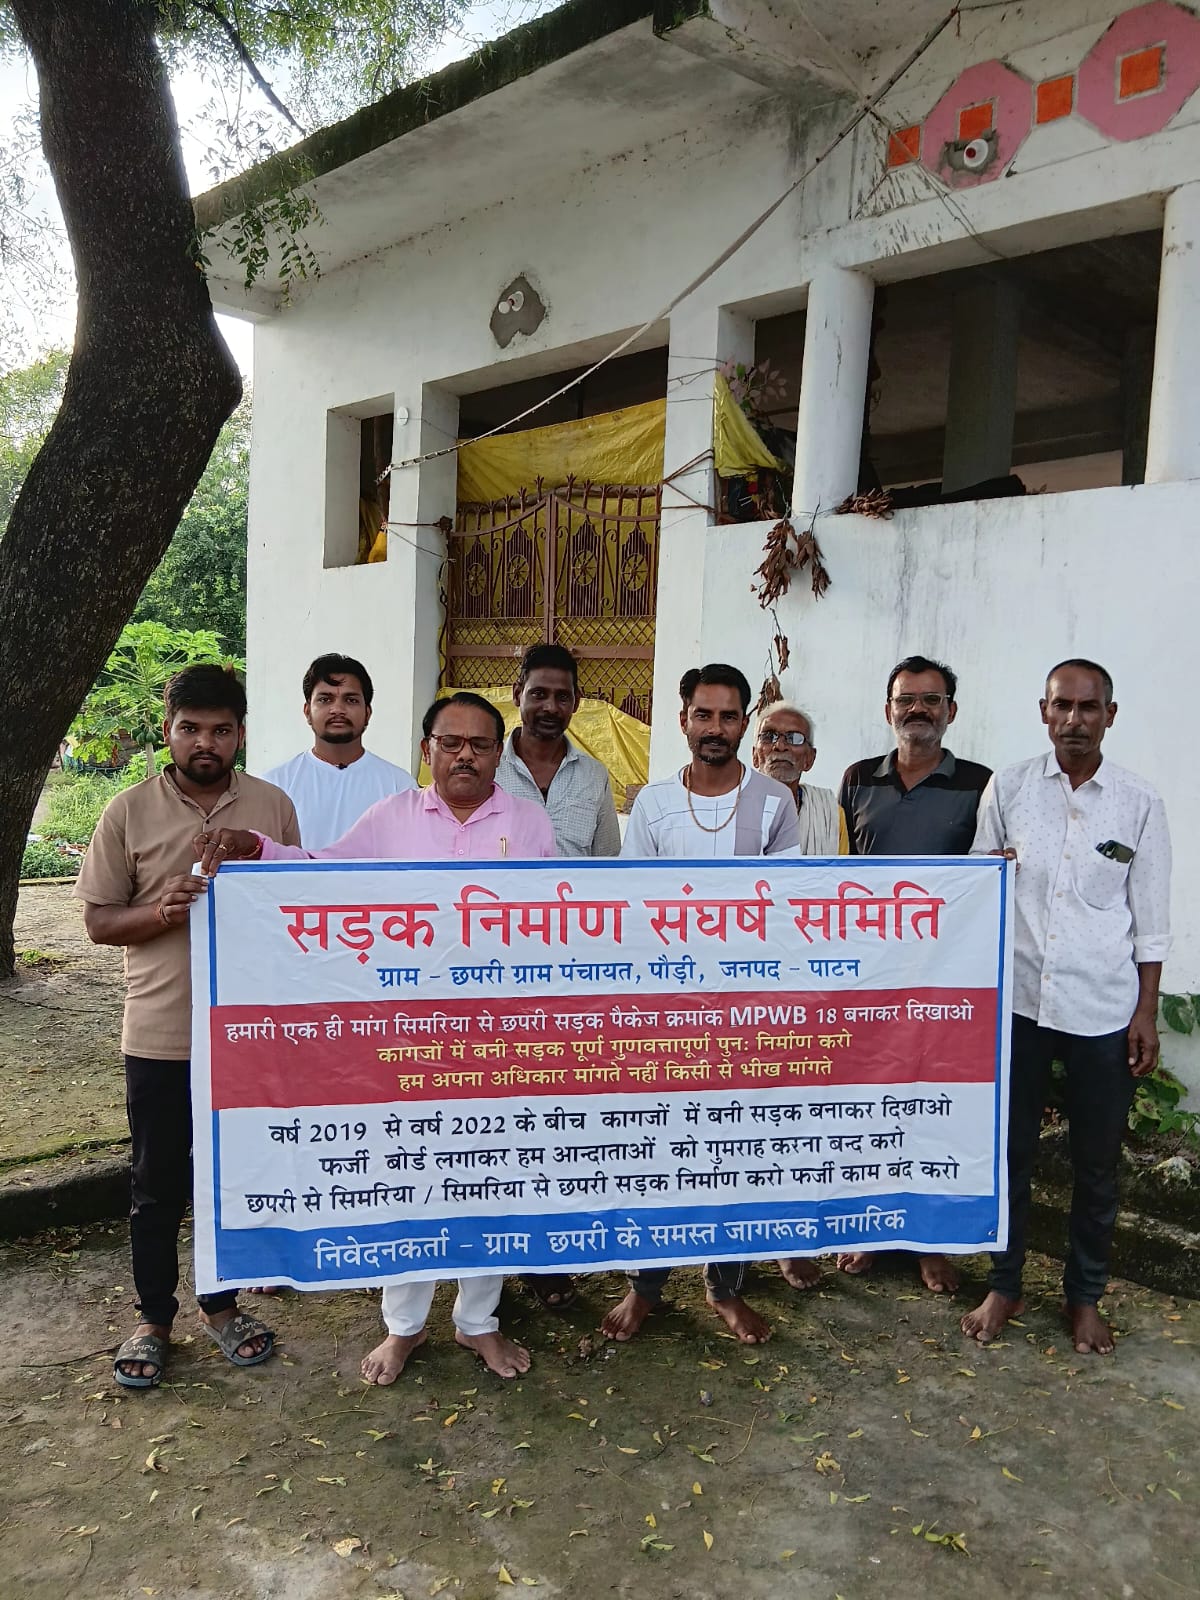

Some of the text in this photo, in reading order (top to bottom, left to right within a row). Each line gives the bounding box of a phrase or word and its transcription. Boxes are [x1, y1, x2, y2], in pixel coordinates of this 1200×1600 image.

[279, 880, 946, 965] सड़क निर्माण संघर्ष समिति
[377, 967, 421, 987] ग्राम
[449, 959, 505, 985] छपरी
[511, 965, 553, 984] ग्राम
[560, 958, 641, 984] पंचायत,
[648, 954, 705, 984] पौड़ी,
[719, 960, 781, 980] जनपद
[808, 958, 861, 979] पाटन
[225, 998, 974, 1045] हमारी एक ही मांग सिमरिया से छपरी सड़क पैकेज क्रमांक MPWB 18 बनाकर दिखाओ
[377, 1040, 443, 1063] कागजों
[450, 1039, 466, 1060] में
[473, 1038, 508, 1058] बनी
[515, 1042, 564, 1060] सड़क
[571, 1035, 604, 1061] पूर्ण
[609, 1031, 710, 1060] गुणवत्तापूर्ण
[757, 1031, 813, 1050] निर्माण
[819, 1029, 852, 1048] करो
[398, 1058, 833, 1089] हम अपना अधिकार मांगते नहीं किसी से भीख मांगते
[269, 1094, 953, 1145] वर्ष 2019 से वर्ष 2022 के बीच कागजों में बनी सड़क बनाकर दिखाओ
[318, 1149, 370, 1176] फर्जी
[384, 1145, 427, 1171] बोर्ड
[434, 1148, 509, 1170] लगाकर
[517, 1148, 545, 1167] हम
[671, 1135, 698, 1159] को
[705, 1139, 765, 1166] गुमराह
[771, 1137, 821, 1155] करना
[828, 1135, 863, 1154] बन्द
[870, 1125, 905, 1151] करो
[245, 1188, 297, 1214] छपरी
[304, 1186, 321, 1212] से
[330, 1183, 415, 1210] सिमरिया
[442, 1178, 525, 1203] सिमरिया
[533, 1172, 552, 1198] से
[557, 1171, 607, 1196] छपरी
[615, 1173, 670, 1195] सड़क
[675, 1163, 739, 1190] निर्माण
[747, 1163, 784, 1187] करो
[790, 1160, 835, 1186] फर्जी
[841, 1163, 881, 1182] काम
[888, 1157, 915, 1181] बंद
[920, 1155, 960, 1180] करो
[314, 1228, 450, 1270] निवेदनकर्ता
[482, 1233, 531, 1255] ग्राम
[547, 1221, 607, 1253] छपरी
[615, 1216, 643, 1248] के
[648, 1221, 717, 1247] समस्त
[724, 1216, 820, 1241] जागरूक
[824, 1205, 907, 1233] नागरिक
